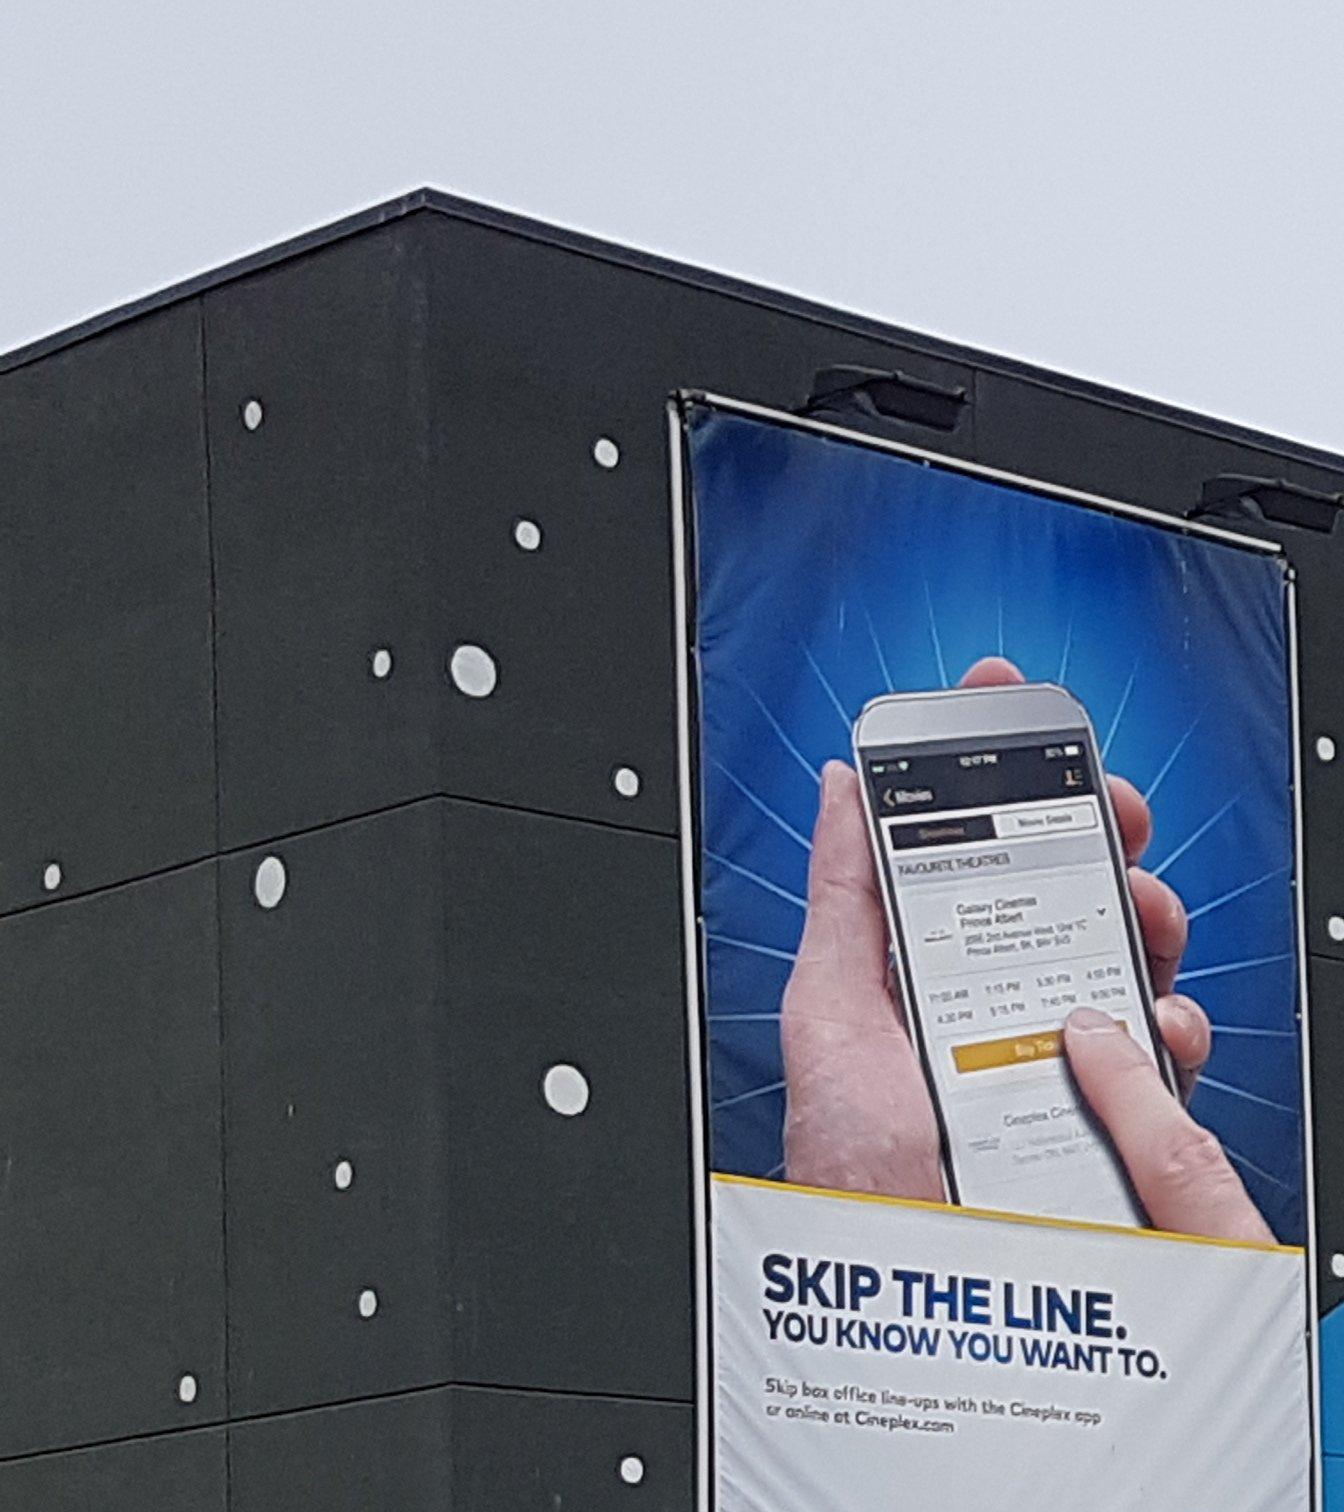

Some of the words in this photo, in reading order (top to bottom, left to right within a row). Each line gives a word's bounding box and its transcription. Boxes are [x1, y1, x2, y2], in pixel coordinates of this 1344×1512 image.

[762, 1253, 881, 1311] SKIP
[892, 1268, 992, 1326] THE
[1003, 1281, 1128, 1341] LINE.
[762, 1308, 829, 1345] YOU
[835, 1317, 941, 1358] KNOW
[947, 1329, 1014, 1365] YOU
[1020, 1336, 1113, 1375] WANT
[1117, 1347, 1169, 1381] TO.
[765, 1376, 798, 1398] Skip
[802, 1380, 829, 1399] box
[834, 1384, 877, 1404] office
[881, 1389, 940, 1412] line-ups
[944, 1395, 977, 1413] with
[982, 1399, 1006, 1416] the
[1010, 1401, 1072, 1422] Cineplex
[1074, 1410, 1103, 1427] app
[766, 1405, 781, 1418] or
[785, 1405, 830, 1423] online
[834, 1411, 851, 1425] at
[855, 1411, 955, 1434] Cineplex.com
